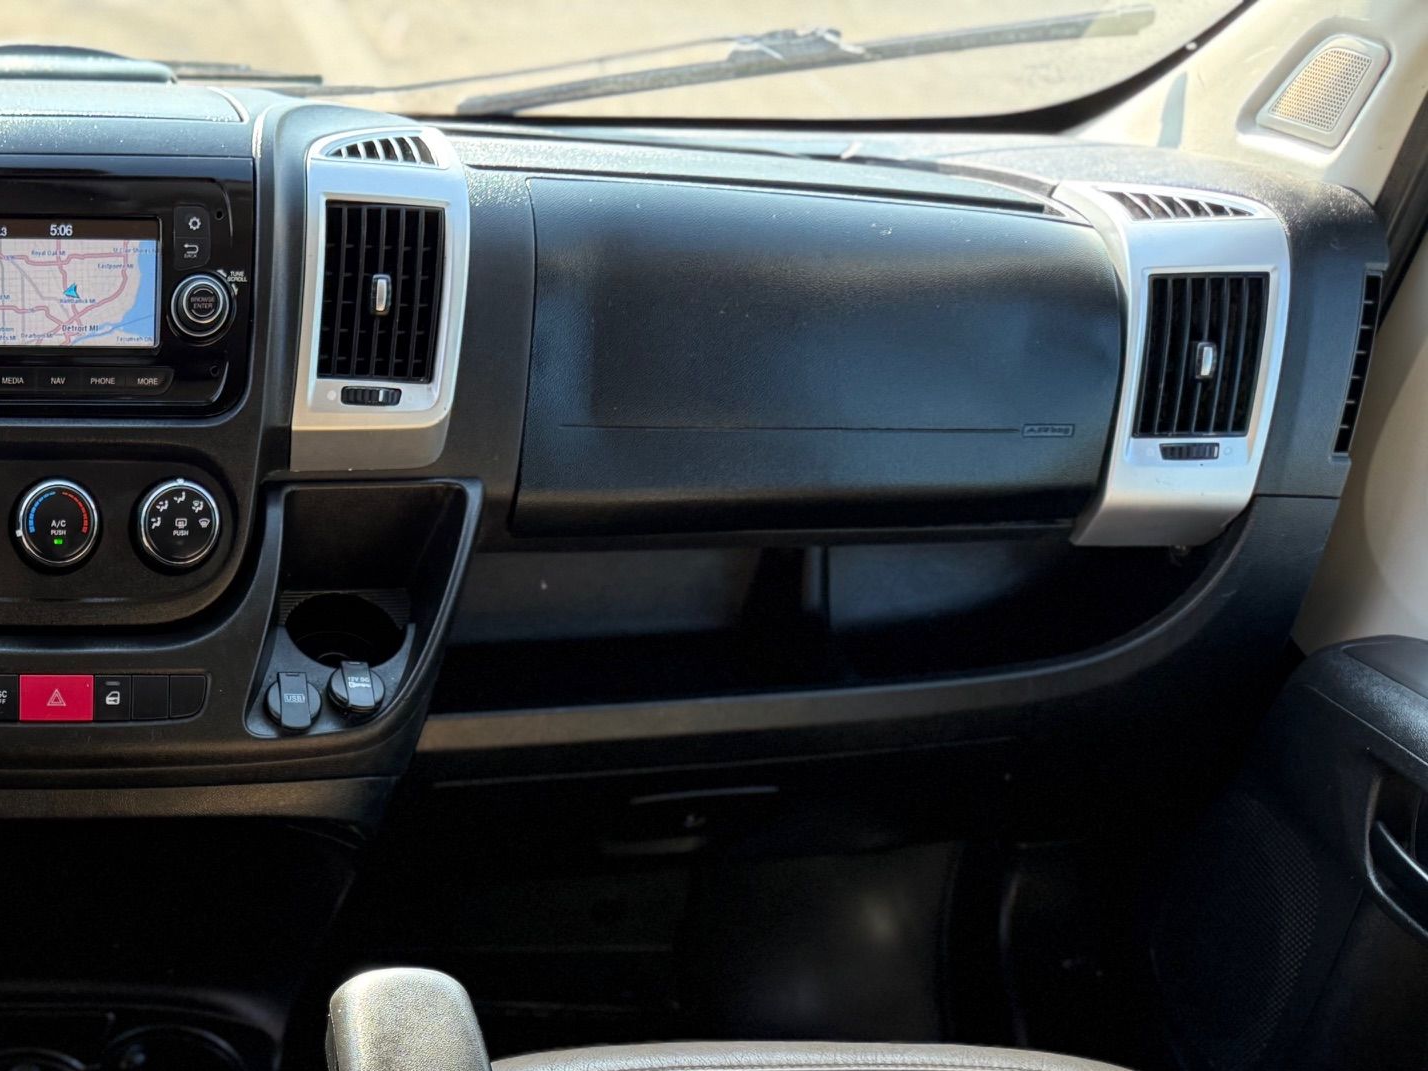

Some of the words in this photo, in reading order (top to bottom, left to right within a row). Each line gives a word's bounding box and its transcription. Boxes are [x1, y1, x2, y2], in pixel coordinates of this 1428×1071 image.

[49, 224, 73, 236] 5:06
[2, 377, 24, 385] MEDIA
[51, 377, 66, 385] NAV
[50, 520, 67, 528] A/C
